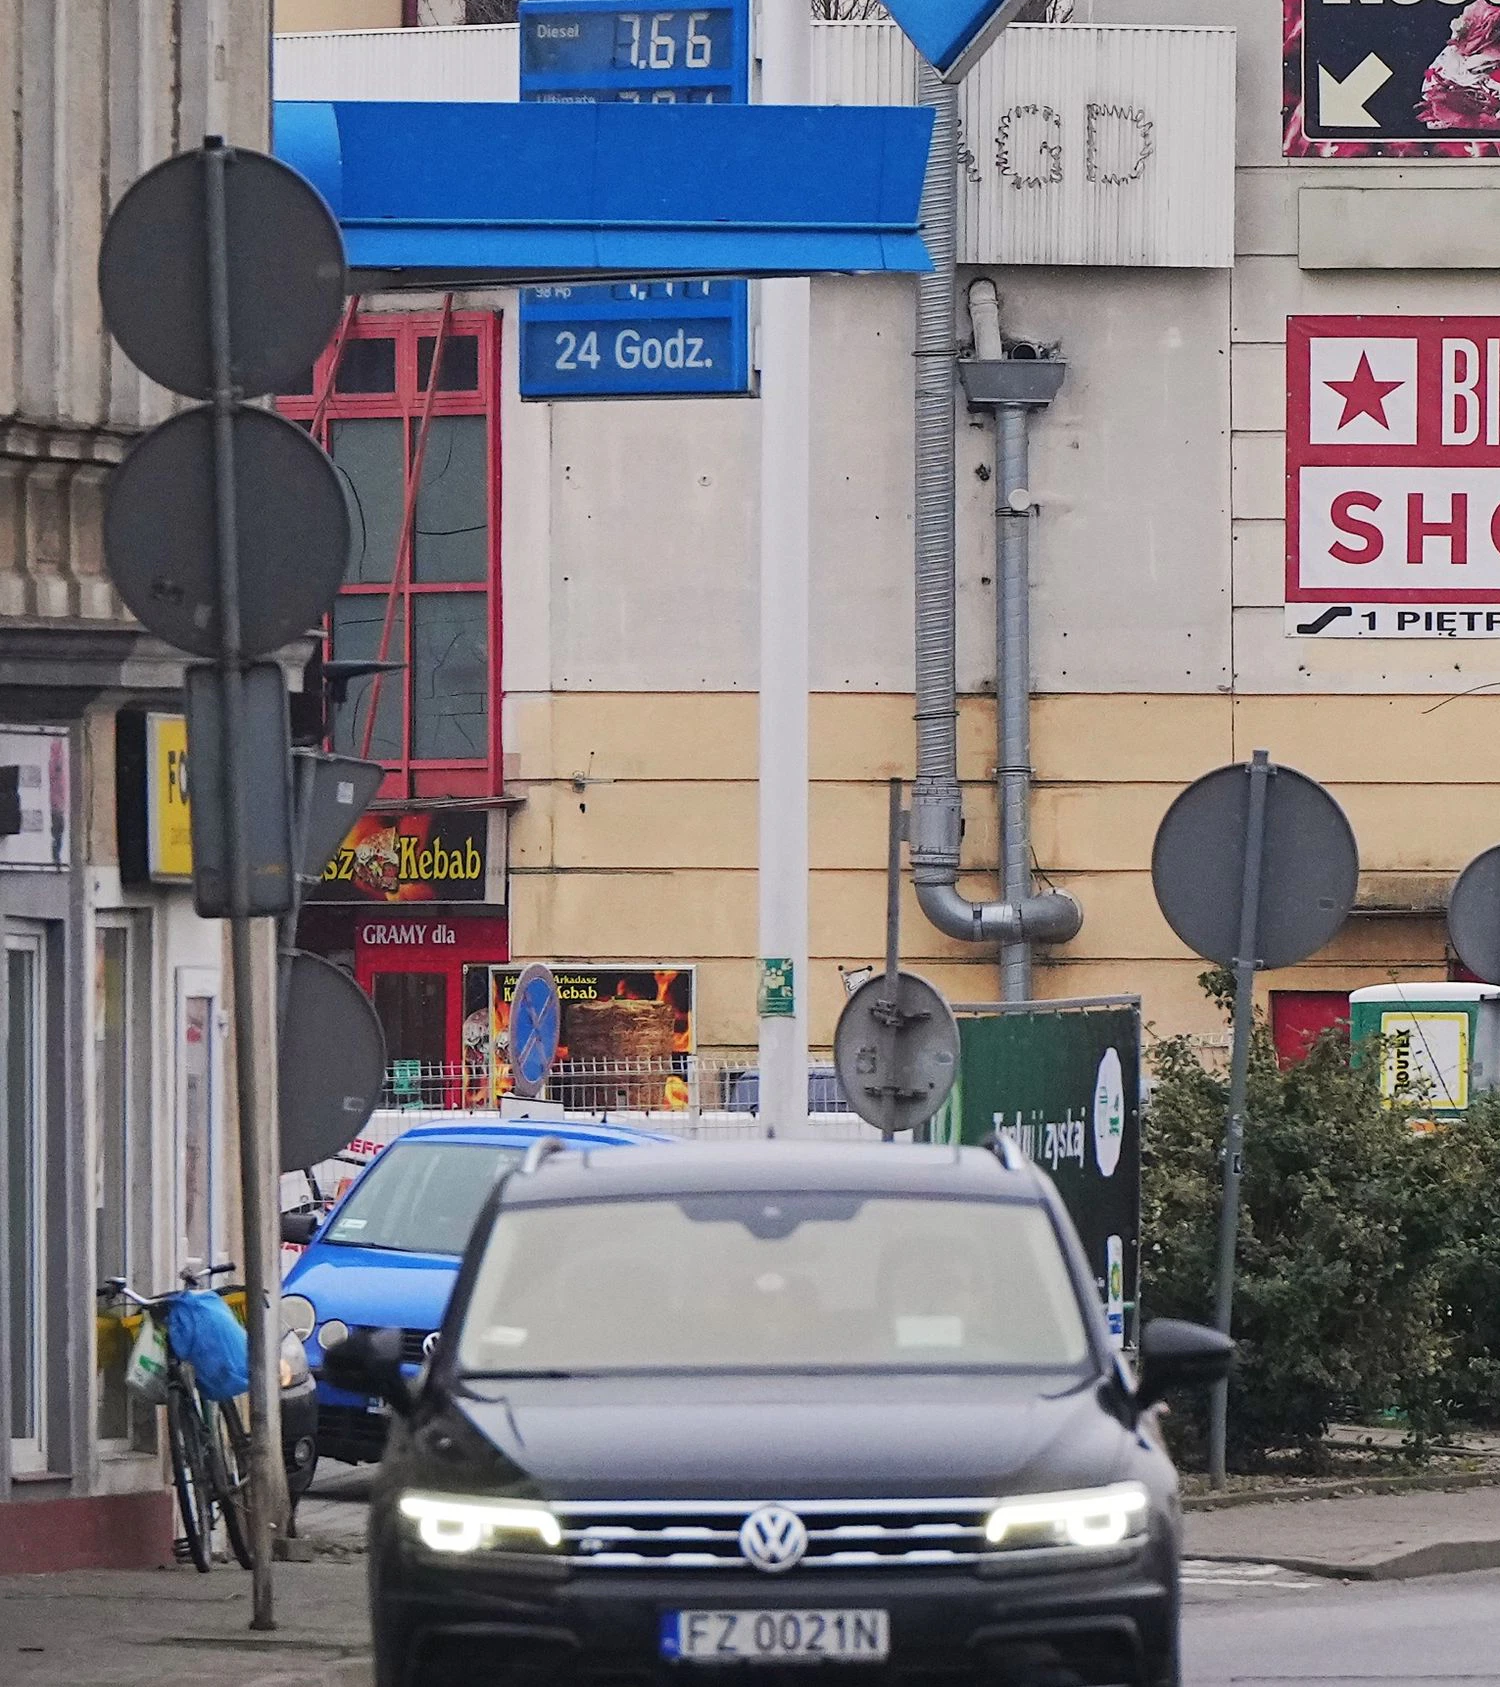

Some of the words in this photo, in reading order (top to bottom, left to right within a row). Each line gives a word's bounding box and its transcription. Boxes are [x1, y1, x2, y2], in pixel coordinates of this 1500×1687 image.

[536, 23, 580, 39] Diesel
[619, 13, 712, 70] 7.66
[555, 330, 600, 370] 24
[614, 327, 713, 370] Godz.
[398, 836, 482, 880] Kebab
[363, 924, 428, 945] GRAMY
[432, 923, 456, 945] dla
[687, 1614, 738, 1652] FZ
[753, 1614, 880, 1652] 0021N
